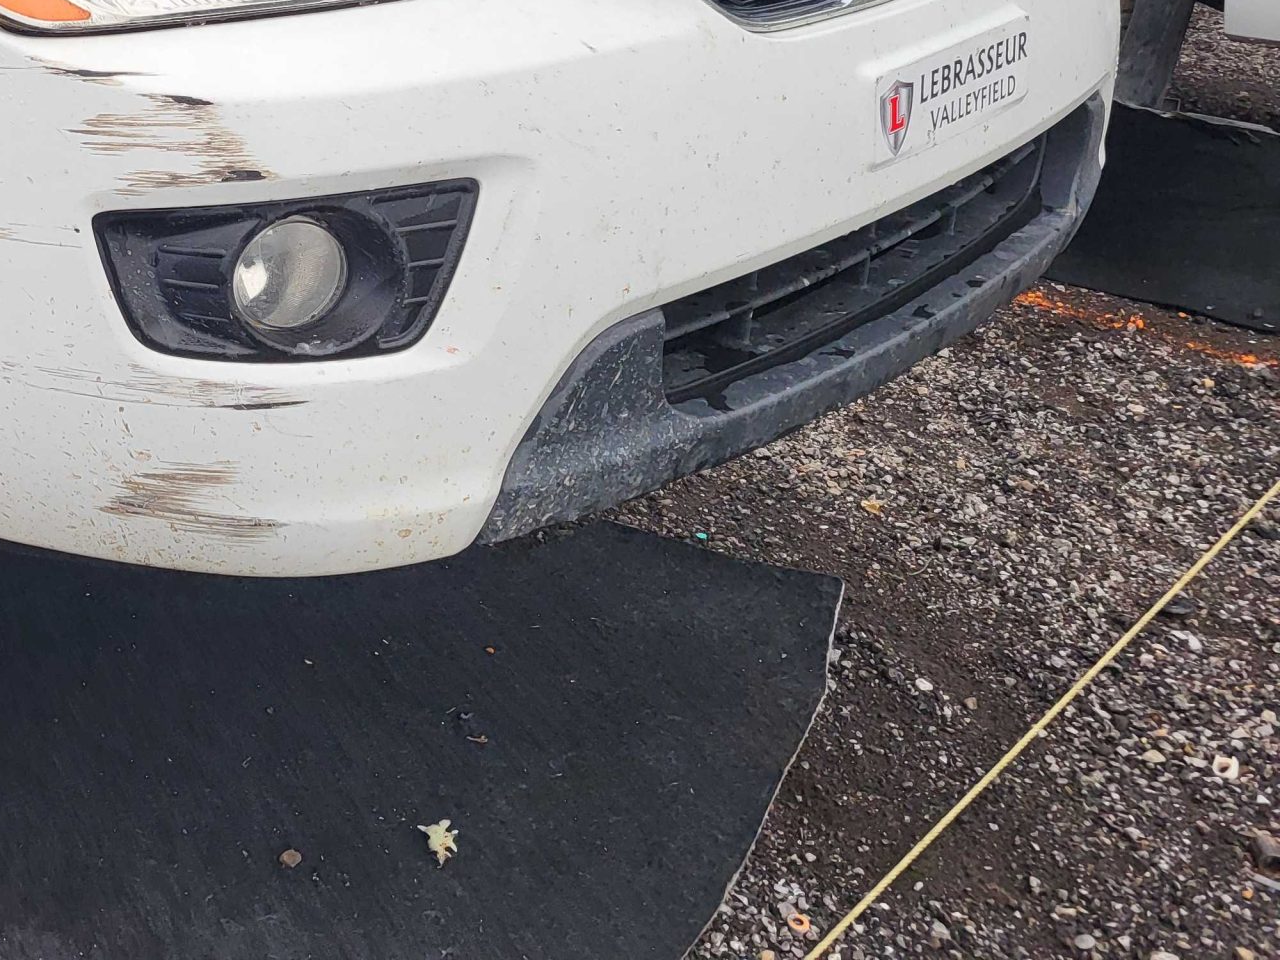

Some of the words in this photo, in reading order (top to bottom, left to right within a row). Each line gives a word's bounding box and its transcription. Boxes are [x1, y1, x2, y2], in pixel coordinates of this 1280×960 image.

[919, 31, 1029, 104] LEBRASSEUR
[887, 94, 907, 136] L
[929, 75, 1017, 131] VALLEYFIELD
